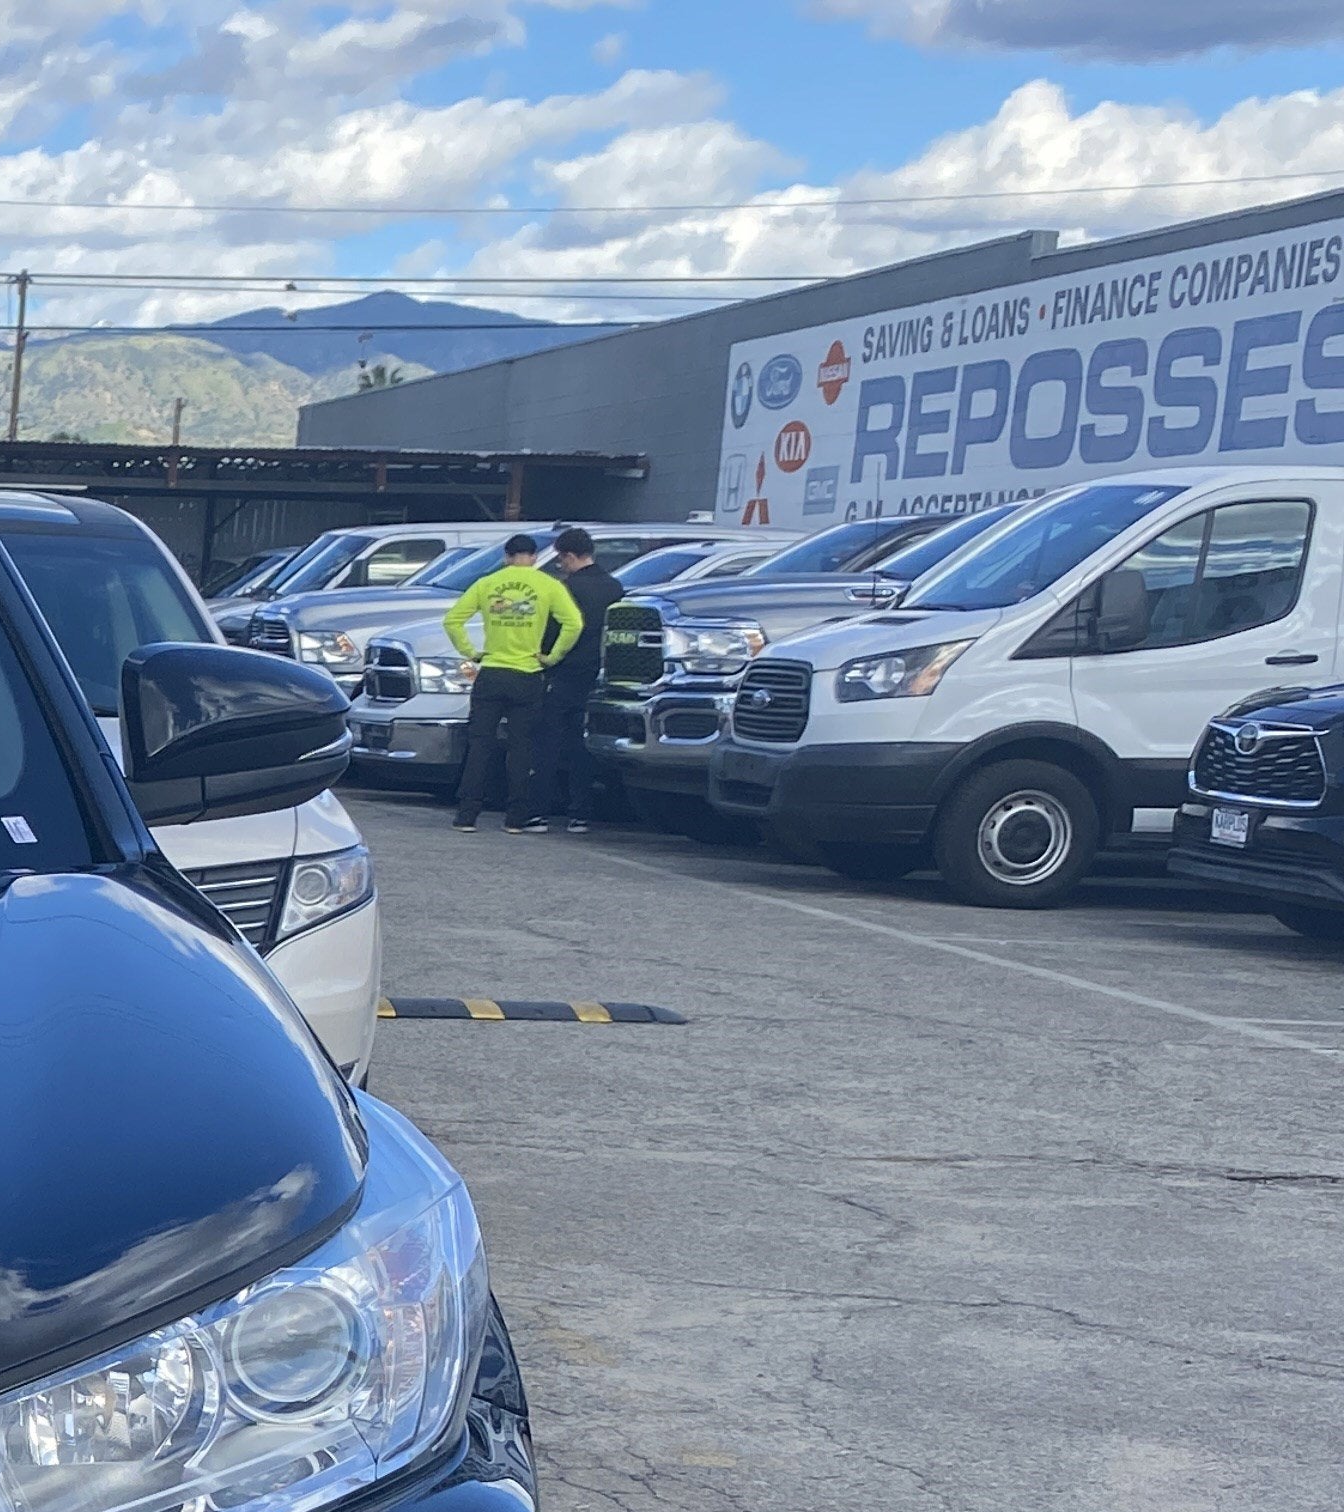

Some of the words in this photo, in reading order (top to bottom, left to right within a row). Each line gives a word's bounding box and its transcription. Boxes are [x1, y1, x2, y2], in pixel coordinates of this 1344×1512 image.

[862, 315, 933, 363] SAVING
[941, 310, 954, 349] &
[958, 296, 1031, 346] LOANS
[1050, 270, 1163, 330] FINANCE
[1169, 235, 1343, 309] COMPANIES
[778, 430, 806, 462] KIA
